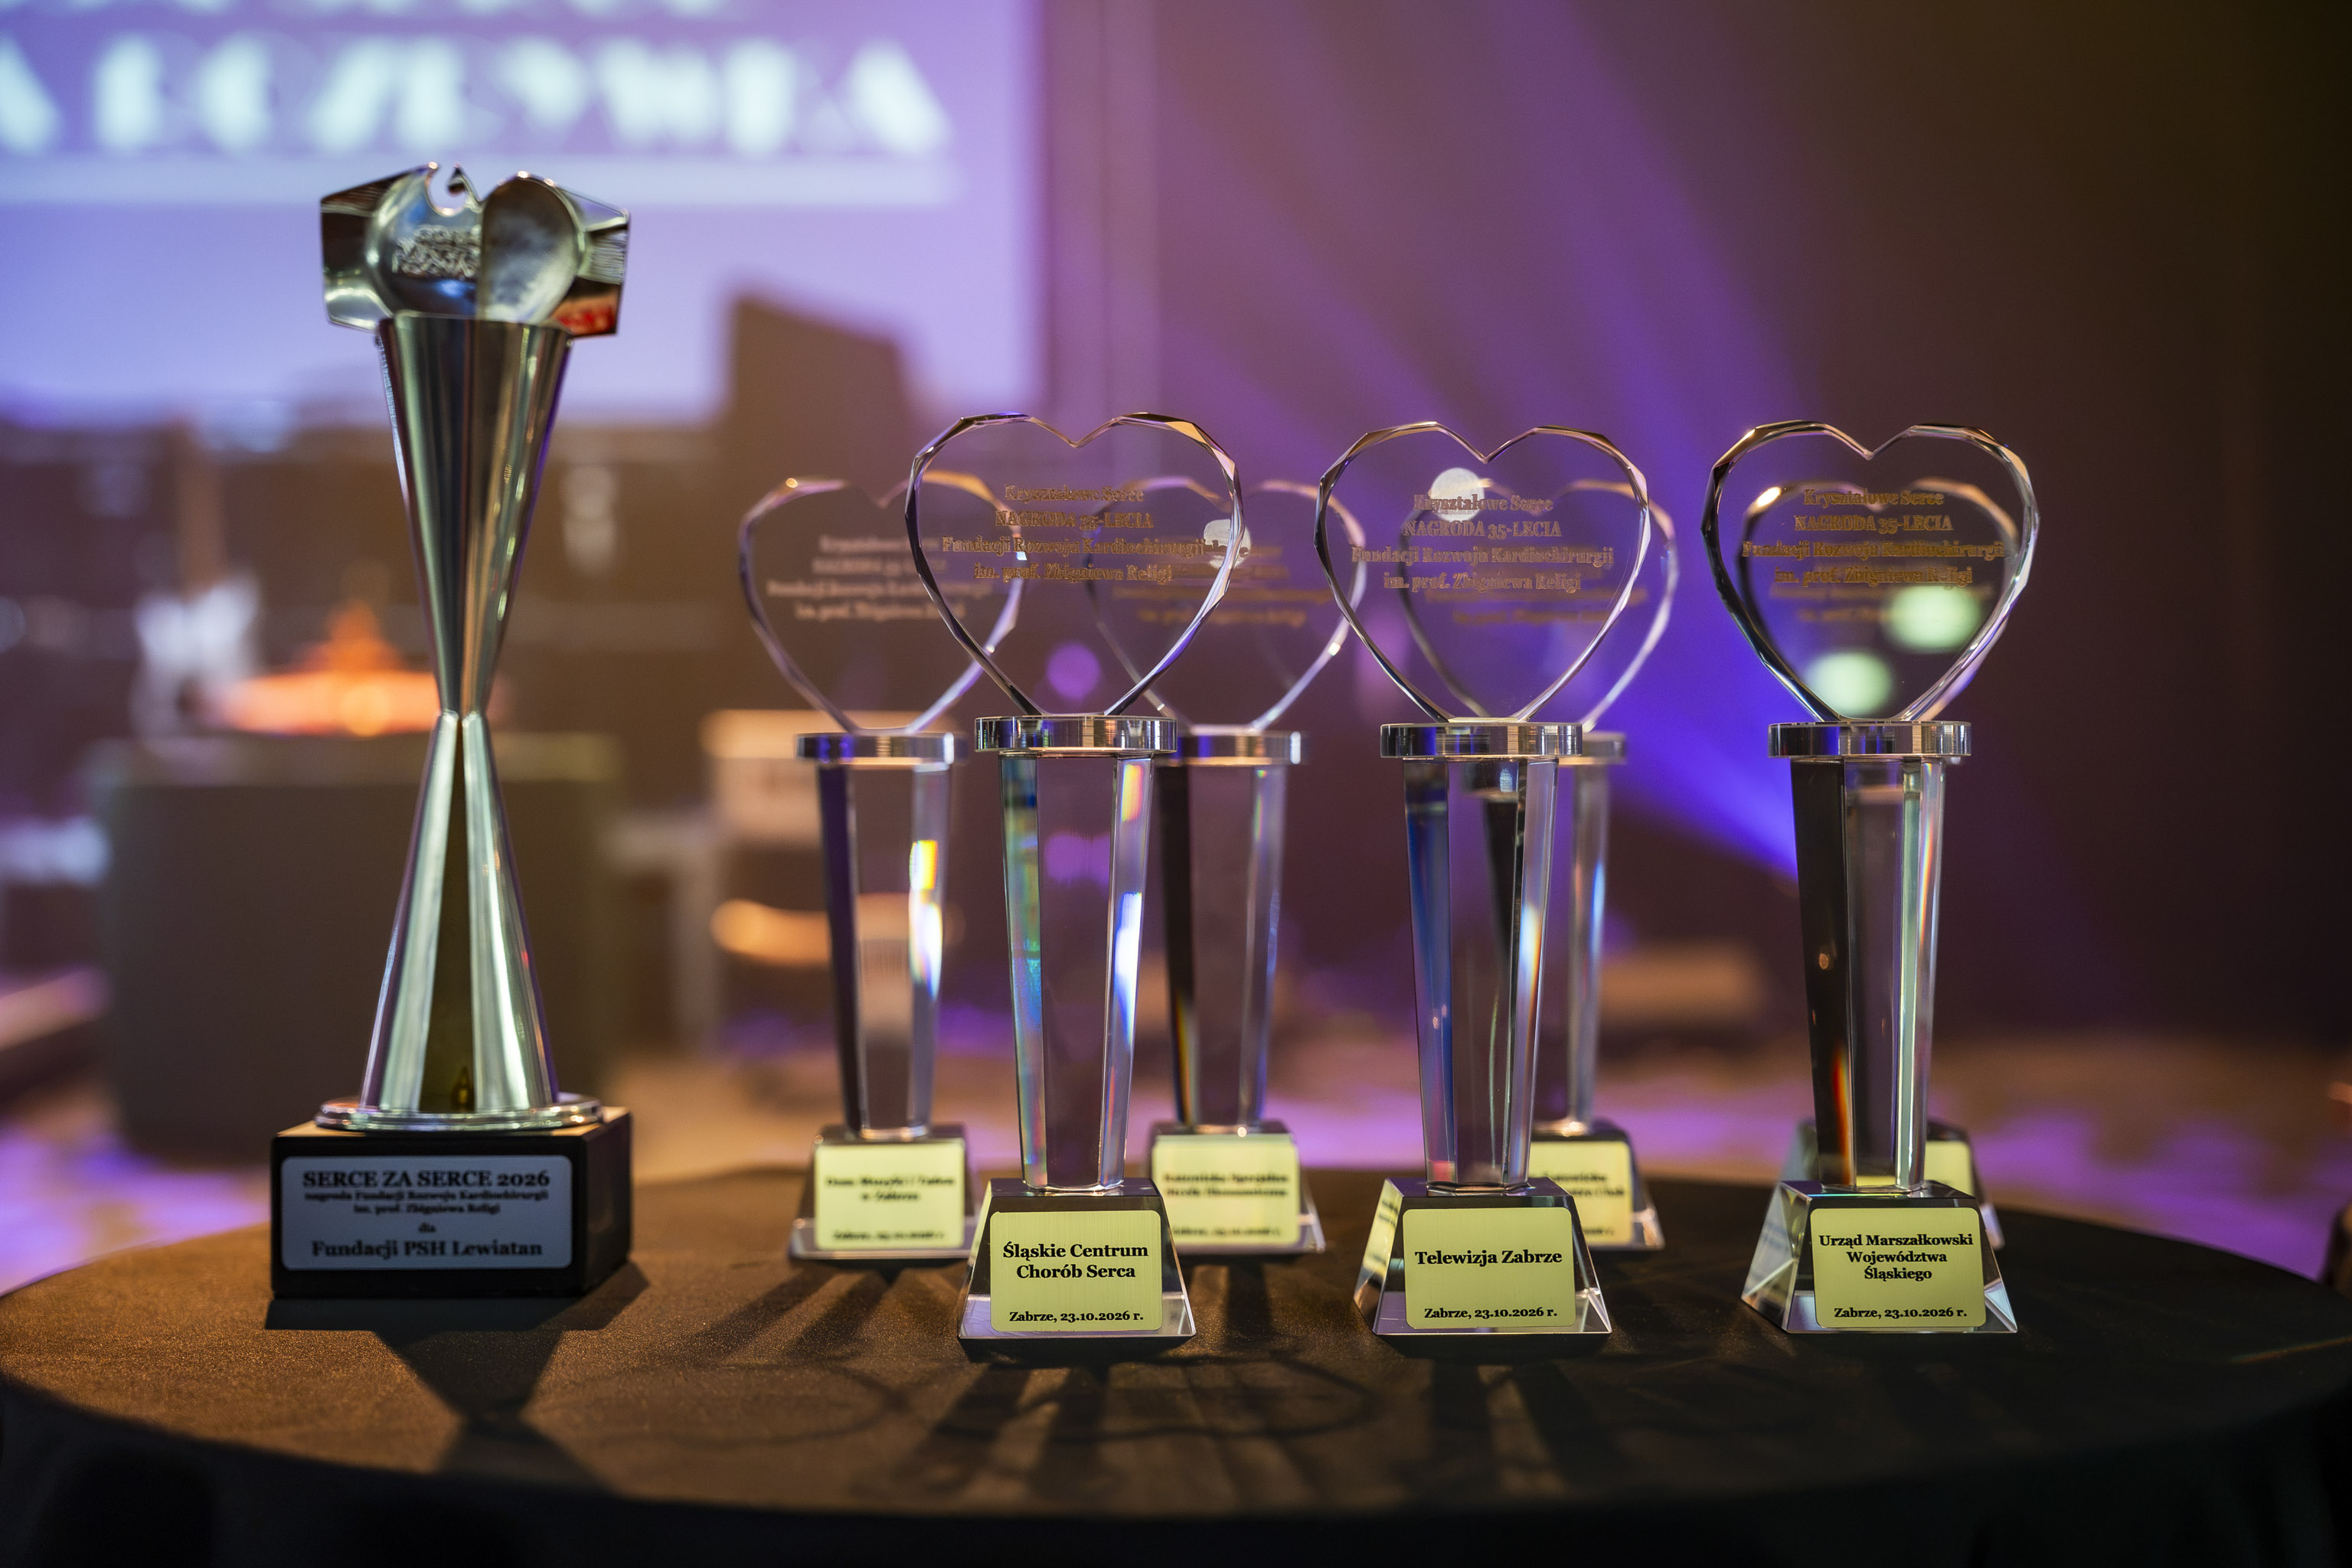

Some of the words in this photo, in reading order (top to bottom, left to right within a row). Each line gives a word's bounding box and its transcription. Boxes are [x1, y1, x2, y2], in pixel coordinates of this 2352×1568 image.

[1102, 485, 1145, 502] Serce
[1900, 489, 1945, 505] Serce
[1413, 494, 1508, 512] Kryształowe
[1511, 495, 1553, 511] Serce
[995, 510, 1076, 528] NAGRODA
[1794, 515, 1876, 531] NAGRODA
[1878, 515, 1953, 534] 35-LECIA
[1403, 520, 1485, 537] NAGRODA
[1488, 521, 1562, 540] 35-LECIA
[942, 536, 1011, 557] Fundacji
[1014, 537, 1080, 557] Rozwoju
[1743, 541, 1811, 560] Fundacji
[1813, 541, 1879, 560] Rozwoju
[1351, 546, 1419, 565] Fundacji
[1423, 546, 1488, 566] Rozwoju
[974, 563, 999, 580] im.
[1775, 567, 1799, 583] im.
[1802, 567, 1841, 587] prof.
[1844, 567, 1923, 586] Zbigniewa
[1384, 572, 1410, 589] im.
[1412, 572, 1450, 593] prof.
[1453, 572, 1533, 593] Zbigniewa
[1535, 573, 1581, 593] Religi
[302, 1170, 377, 1188] SERCE
[383, 1170, 412, 1187] ZA
[417, 1170, 492, 1187] SERCE
[497, 1170, 550, 1187] 2026
[418, 1223, 436, 1233] dla
[312, 1240, 398, 1259] Fundacji
[404, 1240, 446, 1256] PSH
[452, 1240, 543, 1256] Lewiatan
[1818, 1234, 1862, 1250] Urząd
[1866, 1233, 1973, 1246] Marszałkowski
[1003, 1241, 1066, 1261] Śląskie
[1070, 1243, 1148, 1258] Centrum
[1415, 1250, 1498, 1267] Telewizja
[1501, 1249, 1563, 1264] Zabrze
[1846, 1250, 1947, 1266] Województwa
[1016, 1263, 1082, 1279] Chorób
[1086, 1264, 1135, 1278] Serca
[1864, 1266, 1932, 1282] Śląskiego
[1009, 1311, 1057, 1323] Zabrze,
[1060, 1310, 1130, 1323] 23.10.2026
[1132, 1312, 1144, 1321] r.
[1424, 1307, 1472, 1319] Zabrze,
[1474, 1306, 1544, 1320] 23.10.2026
[1546, 1308, 1557, 1317] r.
[1834, 1308, 1882, 1319] Zabrze,
[1884, 1307, 1954, 1319] 23.10.2026
[1956, 1308, 1968, 1317] r.
